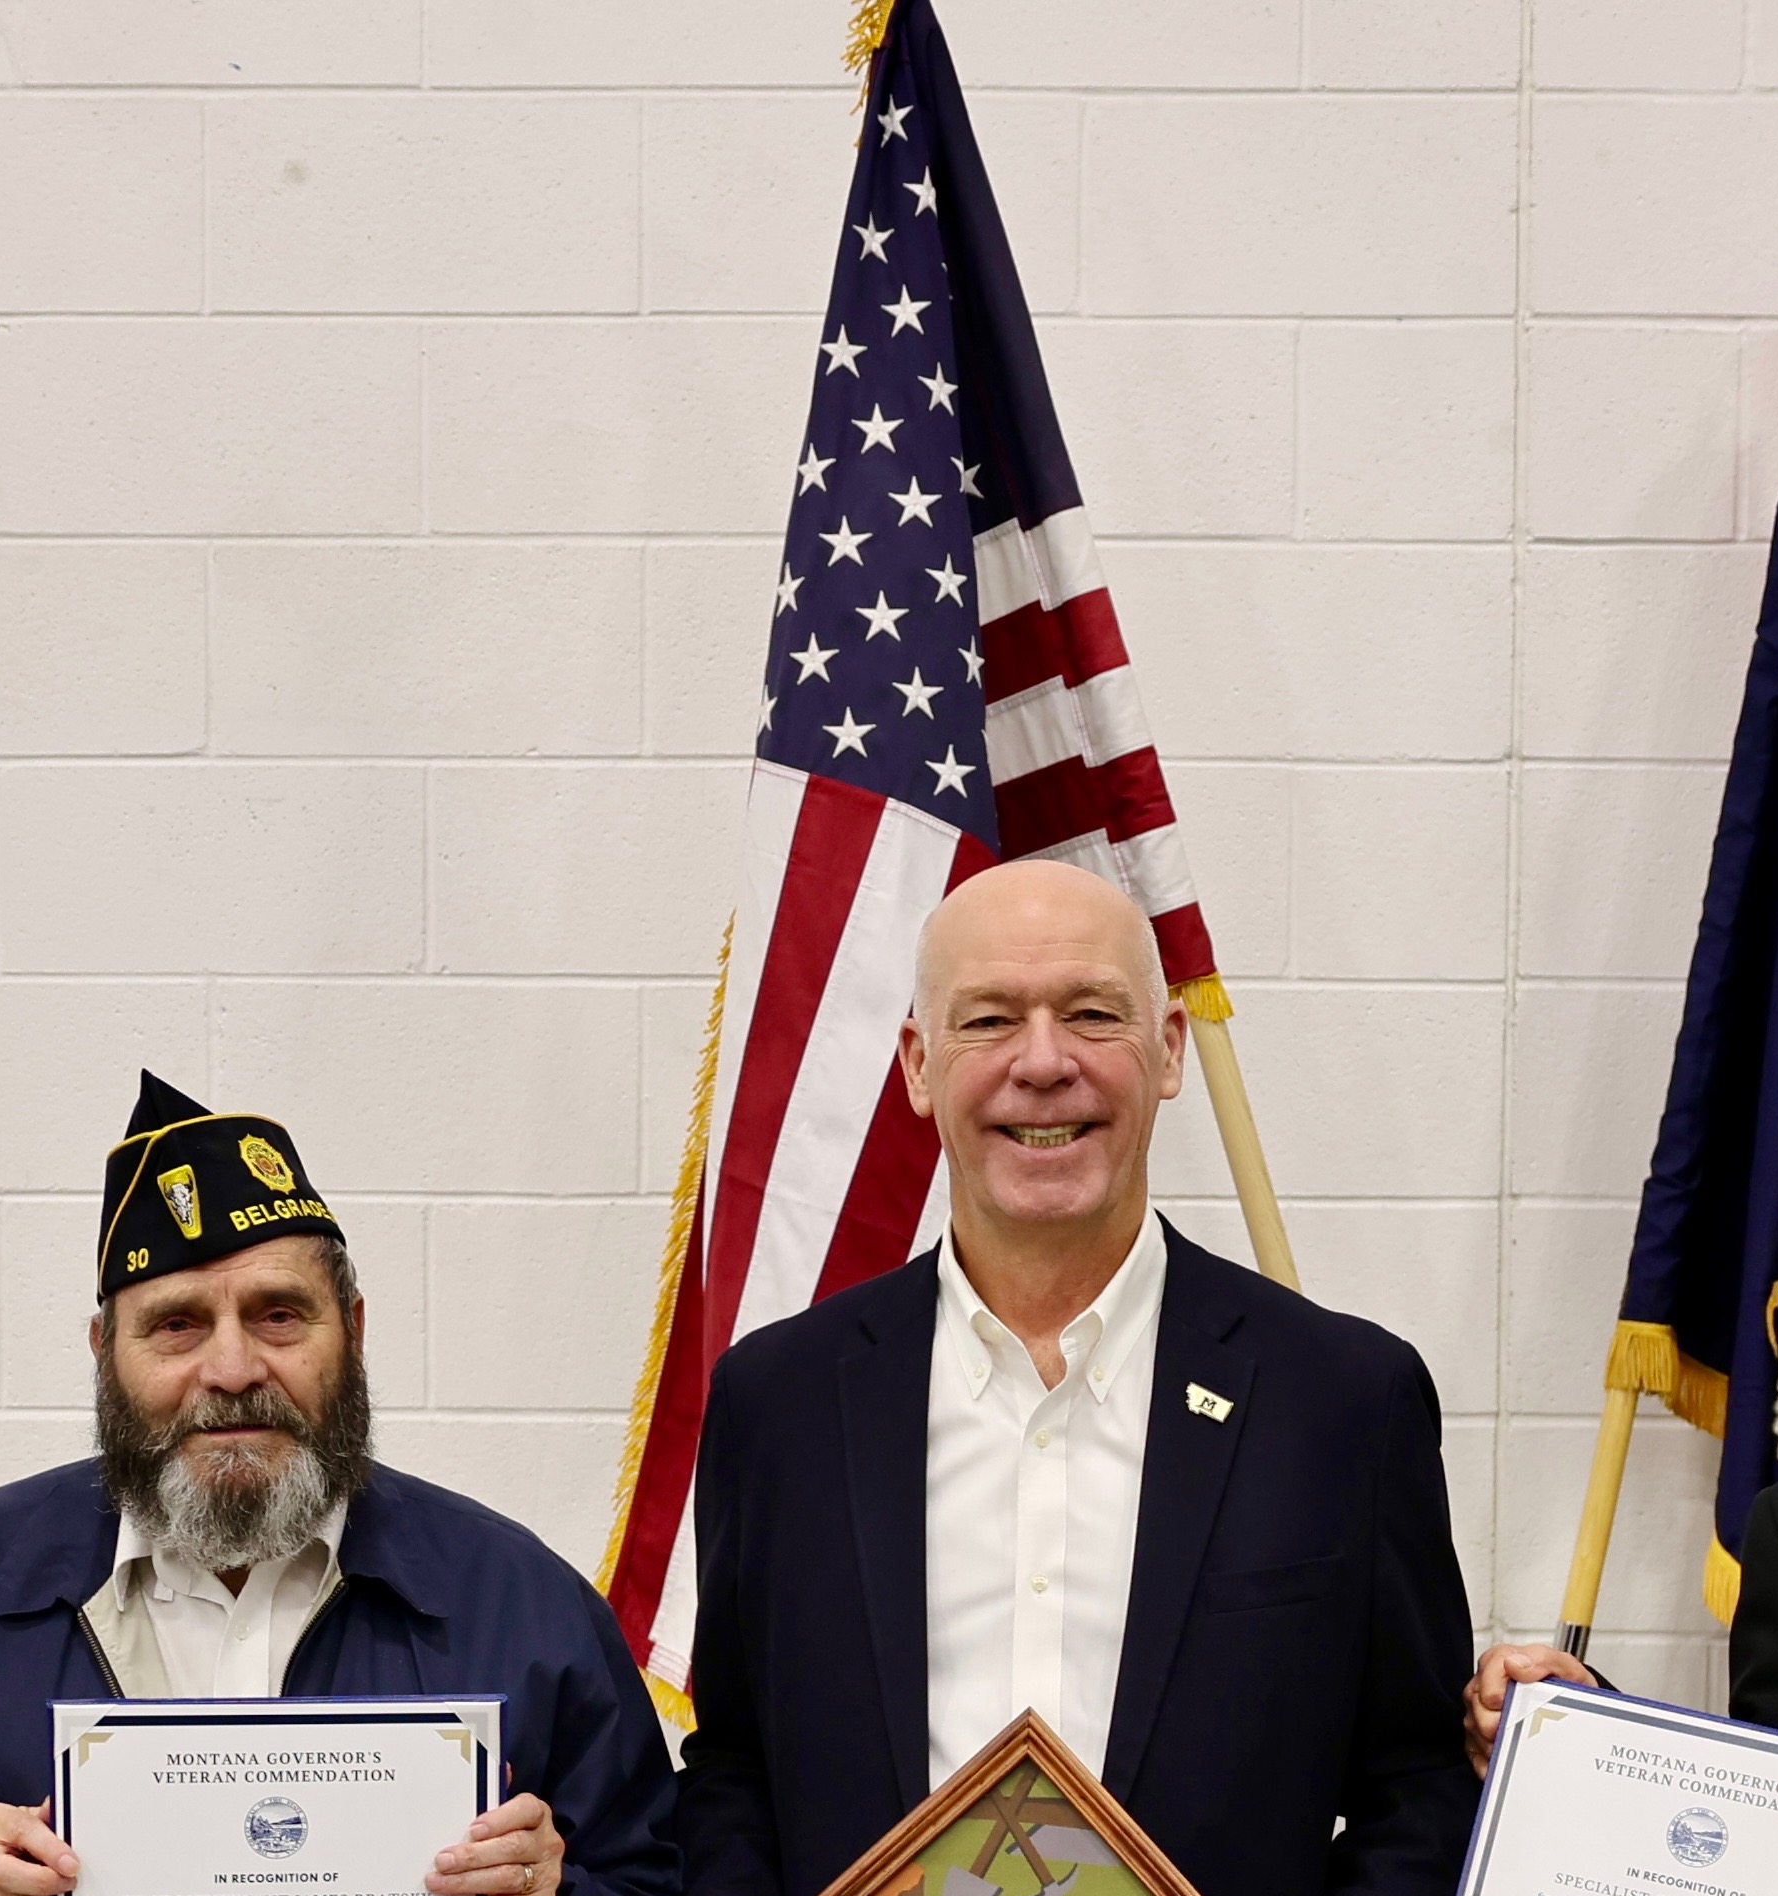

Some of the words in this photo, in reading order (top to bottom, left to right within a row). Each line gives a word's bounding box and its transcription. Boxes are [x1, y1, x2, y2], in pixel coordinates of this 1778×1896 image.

[127, 1248, 149, 1272] 30
[167, 1752, 259, 1765] MONTANA
[266, 1751, 381, 1765] GOVERNOR'S
[1609, 1744, 1697, 1775] MONTANA
[152, 1771, 236, 1783] VETERAN
[244, 1769, 395, 1783] COMMENDATION
[1594, 1757, 1673, 1786] VETERAN
[214, 1874, 227, 1883] IN
[231, 1872, 318, 1883] RECOGNITION
[322, 1872, 338, 1882] OF
[1626, 1866, 1640, 1878] IN
